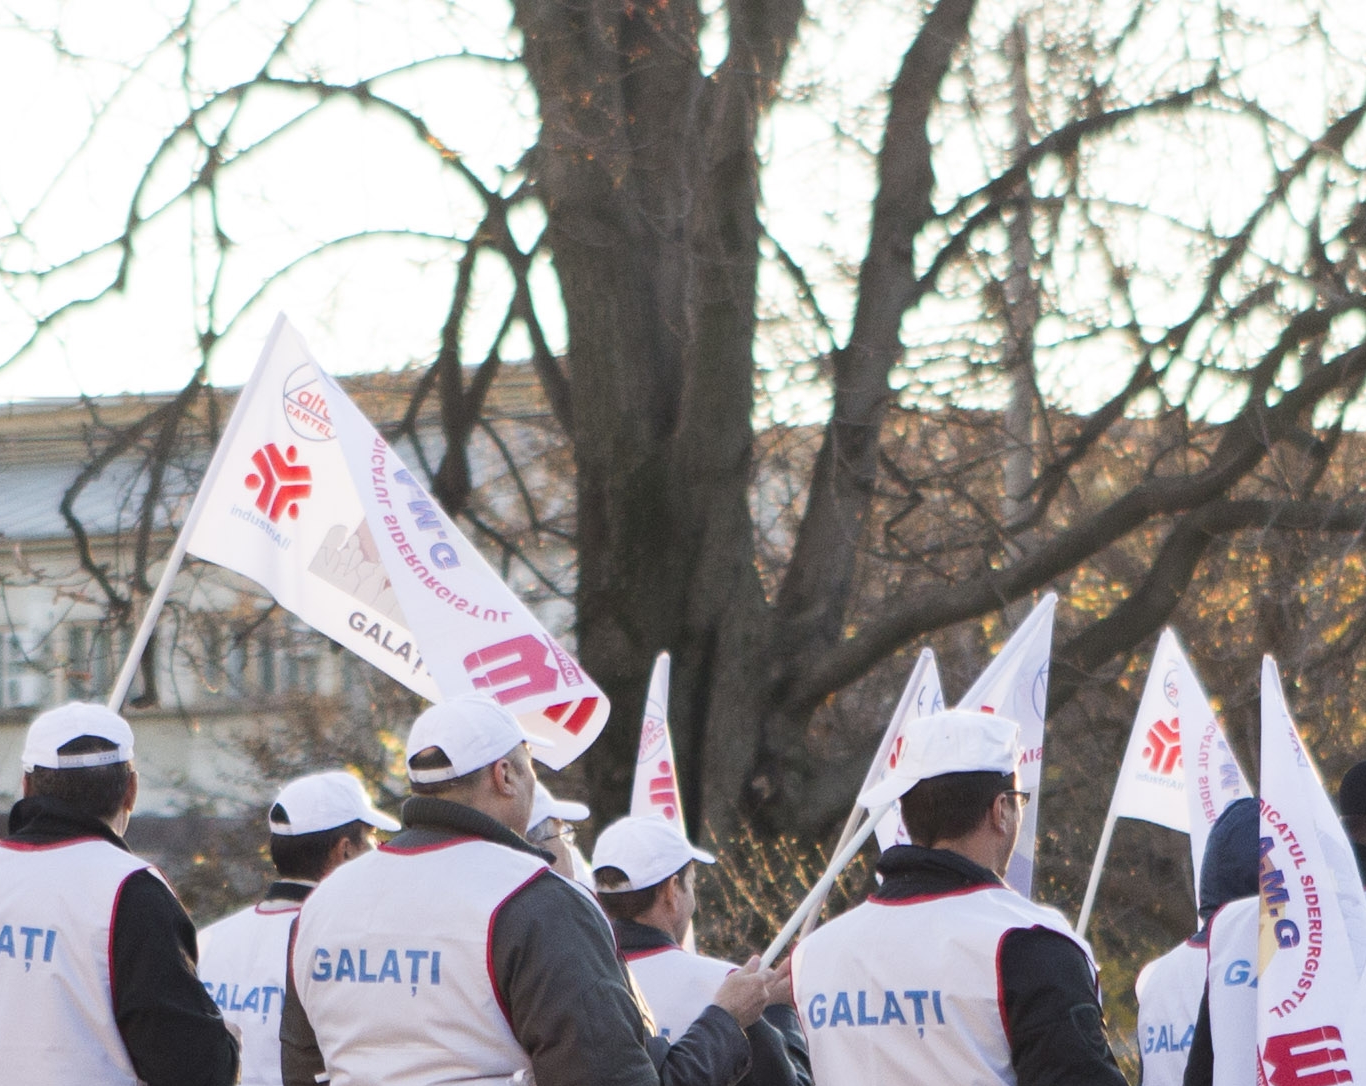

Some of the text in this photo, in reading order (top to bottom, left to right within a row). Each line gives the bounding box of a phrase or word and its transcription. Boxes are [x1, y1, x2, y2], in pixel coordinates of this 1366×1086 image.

[285, 403, 333, 440] CARTEL
[1268, 874, 1323, 1019] SIDERURGISTUL
[311, 947, 442, 997] GALAȚI
[809, 990, 946, 1039] GALAȚI
